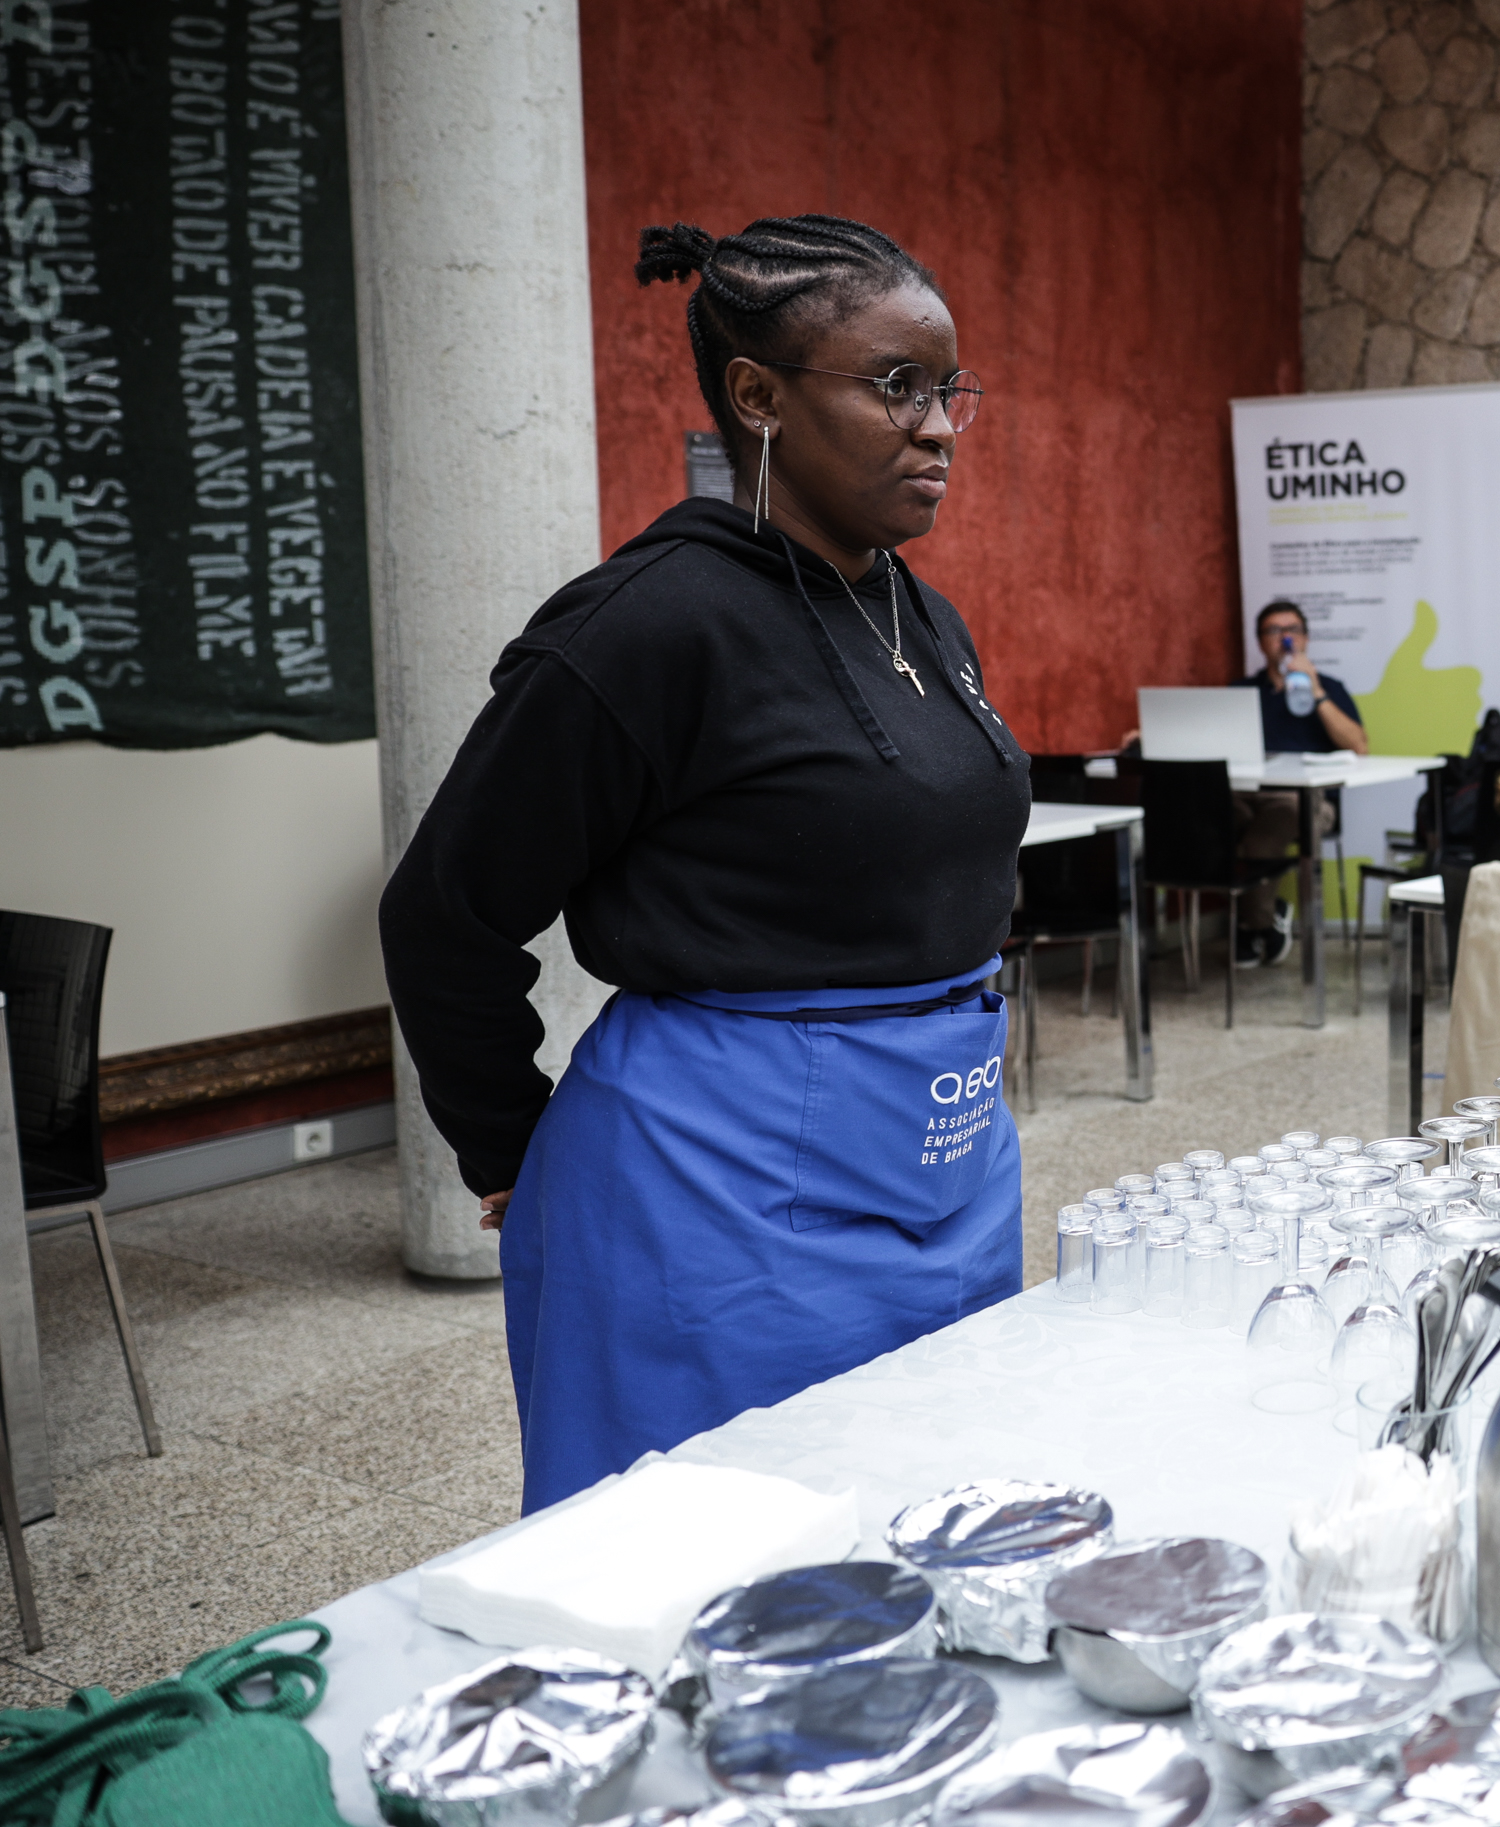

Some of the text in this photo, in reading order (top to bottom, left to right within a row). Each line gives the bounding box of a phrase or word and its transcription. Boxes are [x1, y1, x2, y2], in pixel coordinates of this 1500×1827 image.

[172, 296, 245, 438] PAUSA
[252, 284, 315, 452] CADEIA
[1264, 437, 1366, 470] ÉTICA
[1266, 469, 1407, 502] UMINHO
[22, 466, 104, 732] DGSP
[187, 521, 257, 662] FILME
[926, 1096, 996, 1131] ASSOCIAÇÃO
[923, 1115, 992, 1148] EMPRESARIAL
[920, 1140, 973, 1165] DE BRAGA
